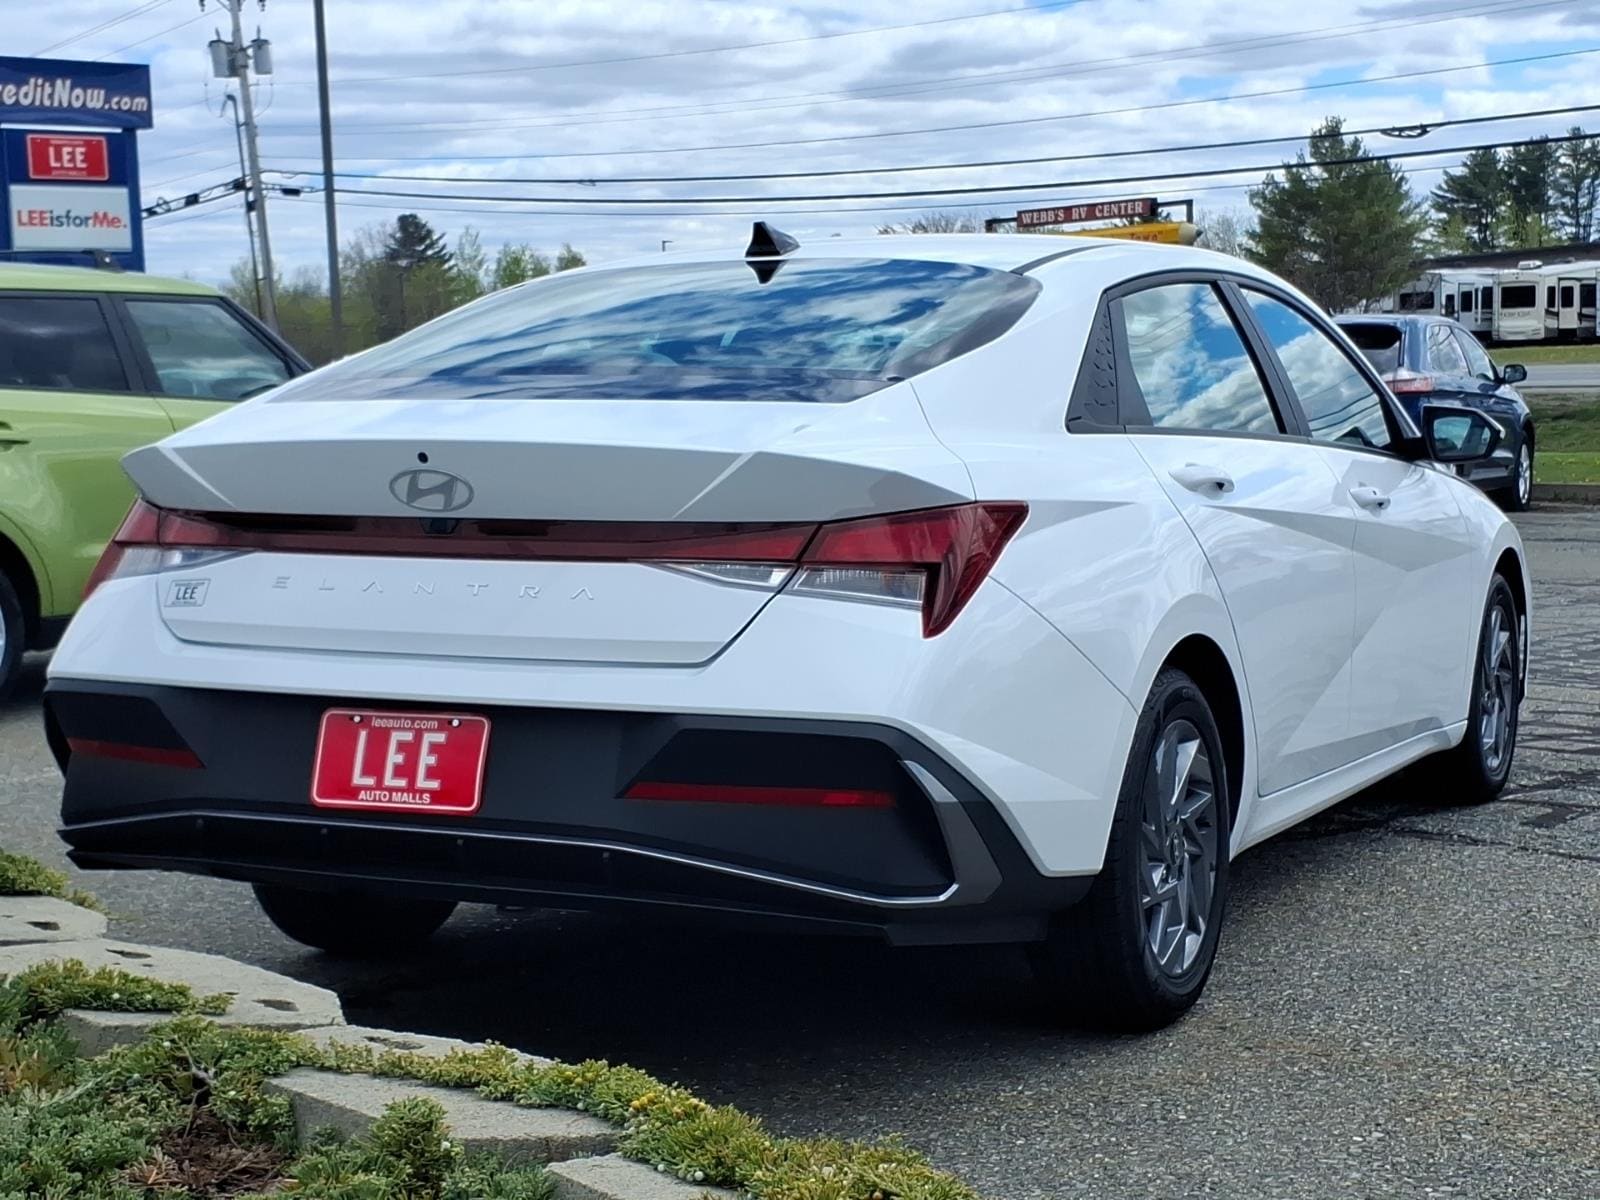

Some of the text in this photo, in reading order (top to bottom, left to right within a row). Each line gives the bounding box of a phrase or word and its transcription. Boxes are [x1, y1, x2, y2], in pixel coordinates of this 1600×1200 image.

[0, 77, 148, 112] editNow.com
[48, 146, 88, 168] LEE
[17, 210, 128, 229] LEEisforMe.
[1021, 201, 1143, 225] WEBB'S RV CENTER
[175, 586, 199, 601] LEE
[271, 575, 595, 601] ELANTRA
[371, 716, 438, 729] leeauto.com
[351, 729, 448, 790] LEE
[358, 790, 431, 804] AUTO MALLS
